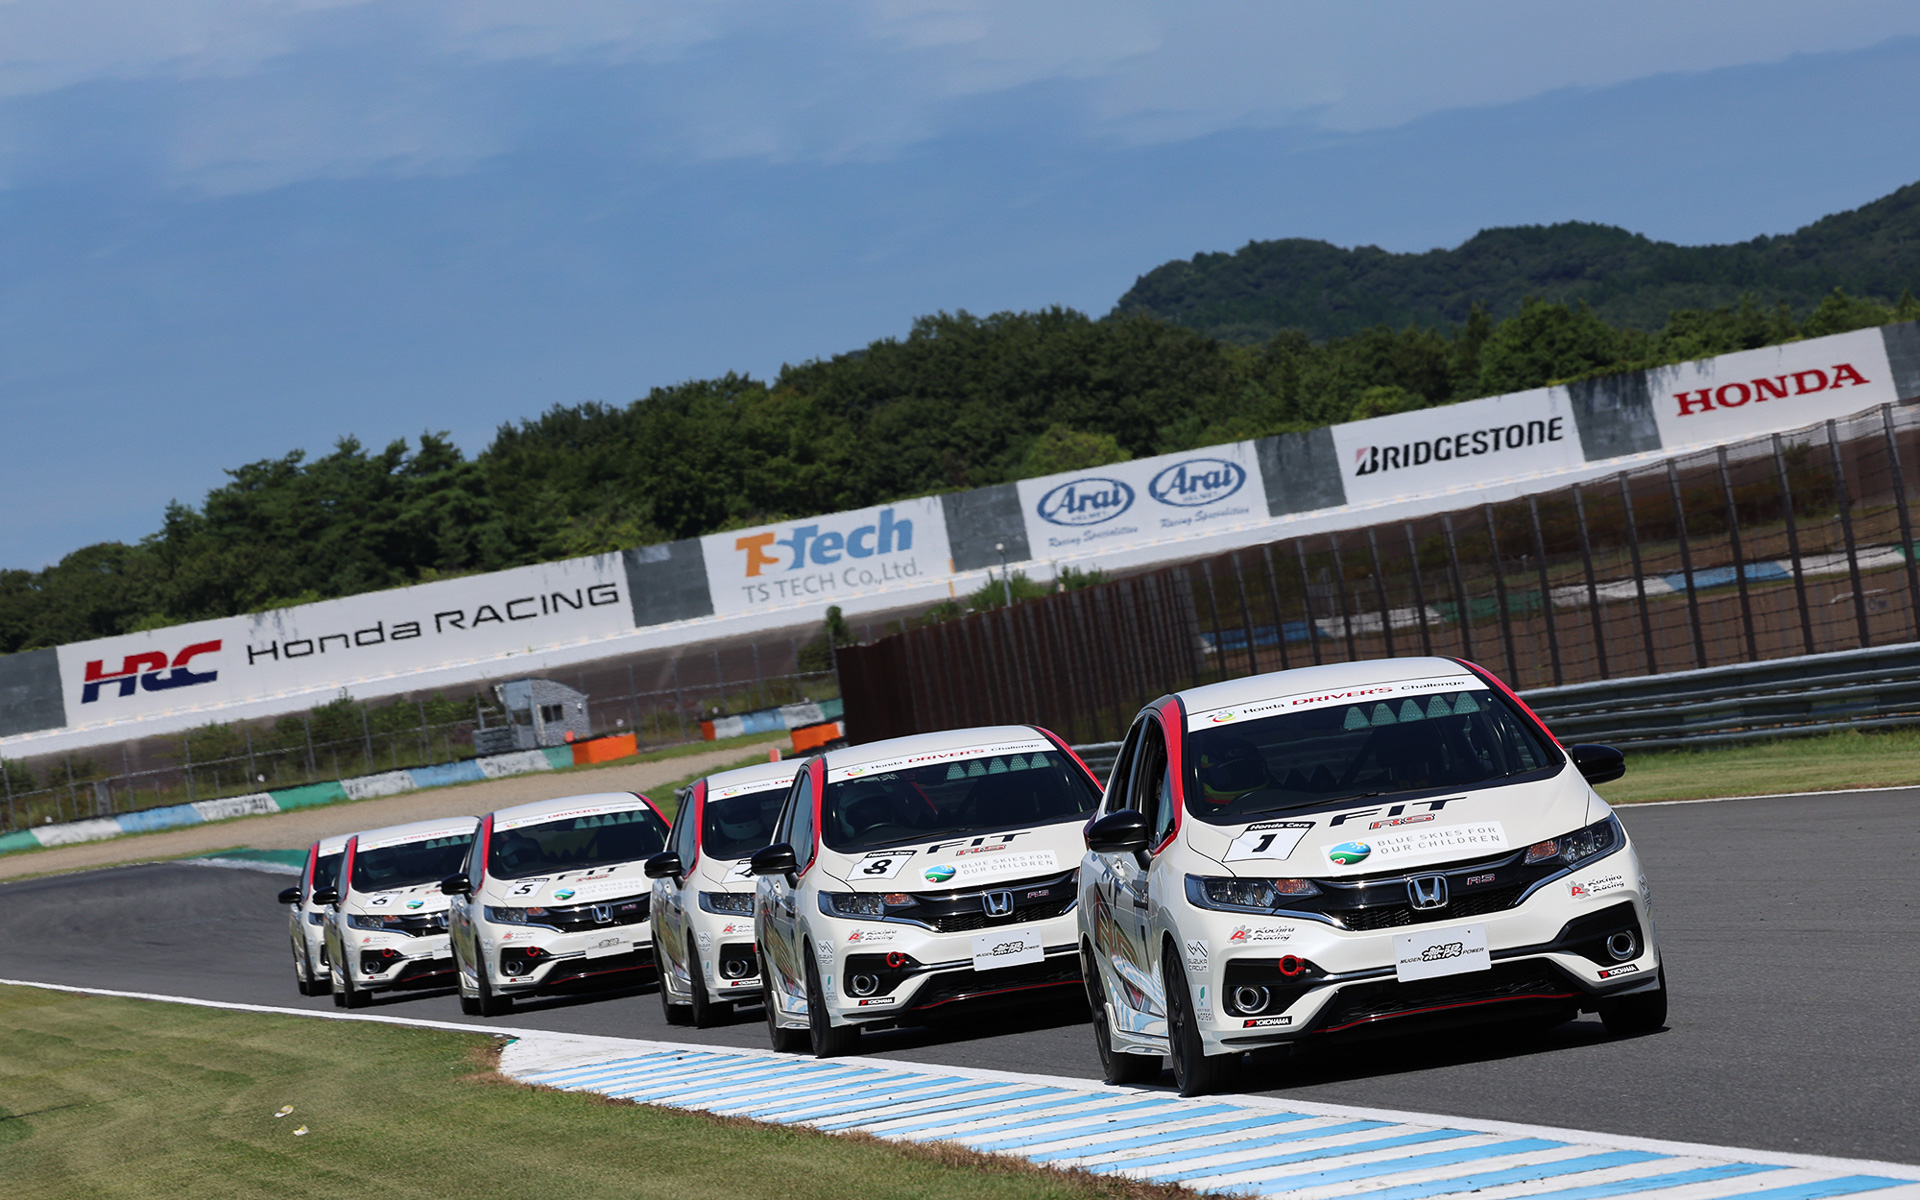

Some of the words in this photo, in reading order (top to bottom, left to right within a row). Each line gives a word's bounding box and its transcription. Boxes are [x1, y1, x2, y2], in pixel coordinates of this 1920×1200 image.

[1674, 362, 1870, 416] HONDA
[1355, 417, 1563, 476] BRIDGESTONE
[1157, 462, 1235, 499] Arai
[1045, 481, 1123, 518] Arai
[742, 583, 770, 603] TS
[774, 572, 836, 599] TECH
[247, 619, 421, 665] Honda
[434, 583, 619, 633] RACING
[81, 639, 222, 704] HRC
[1243, 702, 1285, 714] Honda
[1292, 686, 1393, 706] DRIVER'S
[1401, 680, 1465, 691] Challenge
[871, 761, 903, 770] Honda
[908, 748, 985, 763] DRIVER'S
[991, 743, 1040, 751] Challenge
[1329, 796, 1467, 827] FIT
[1250, 822, 1284, 831] Honda
[1286, 821, 1311, 829] Cars
[1368, 813, 1435, 831] RS
[927, 832, 1031, 854] FIT
[1252, 833, 1278, 853] 1
[1377, 835, 1415, 847] BLUE
[1419, 829, 1463, 841] SKIES
[1467, 826, 1497, 835] FOR
[1380, 844, 1412, 855] OUR
[1418, 834, 1500, 849] CHILDREN
[956, 844, 1006, 856] RS
[961, 861, 990, 870] BLUE
[993, 856, 1025, 865] SKIES
[1029, 853, 1051, 861] FOR
[963, 867, 987, 875] OUR
[991, 860, 1053, 871] CHILDREN
[557, 865, 627, 880] FIT
[1467, 874, 1495, 886] RS
[514, 884, 533, 894] 5
[1027, 890, 1049, 899] RS
[1593, 881, 1625, 893] Racing
[1253, 933, 1291, 942] Racing
[1400, 956, 1422, 964] MUGEN
[1462, 947, 1484, 955] POWER
[1256, 1018, 1289, 1026] YOKOHAMA
